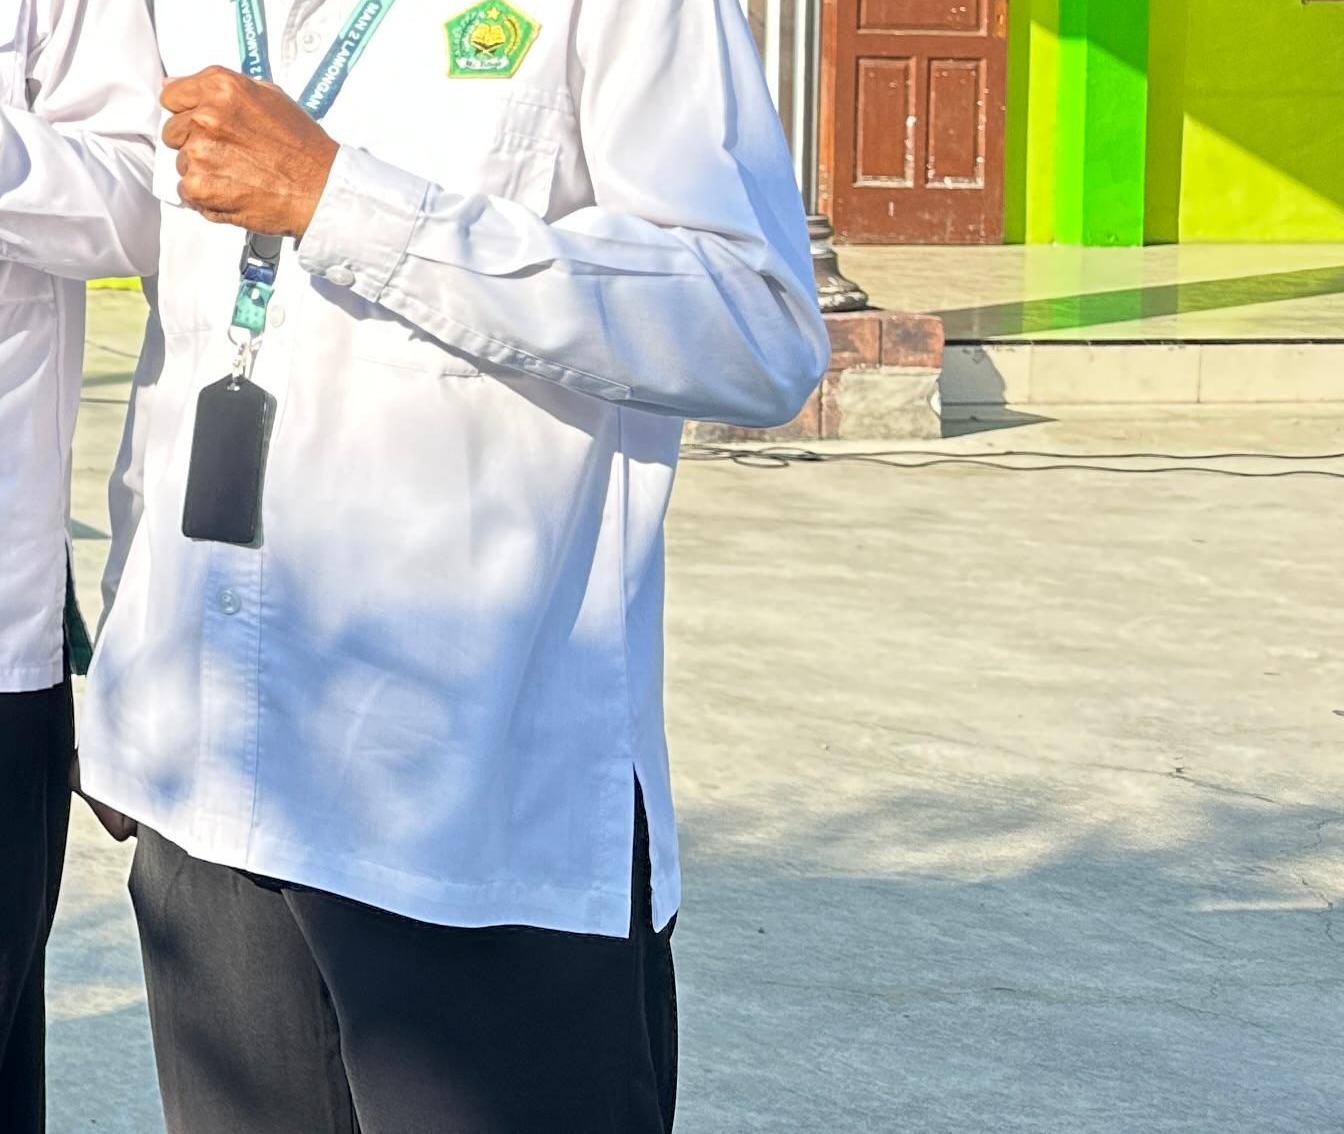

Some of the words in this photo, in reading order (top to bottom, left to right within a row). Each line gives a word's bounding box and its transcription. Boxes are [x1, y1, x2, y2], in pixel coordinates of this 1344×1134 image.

[355, 2, 379, 31] MAN
[348, 30, 361, 41] 2
[306, 40, 352, 110] LAMONGAN
